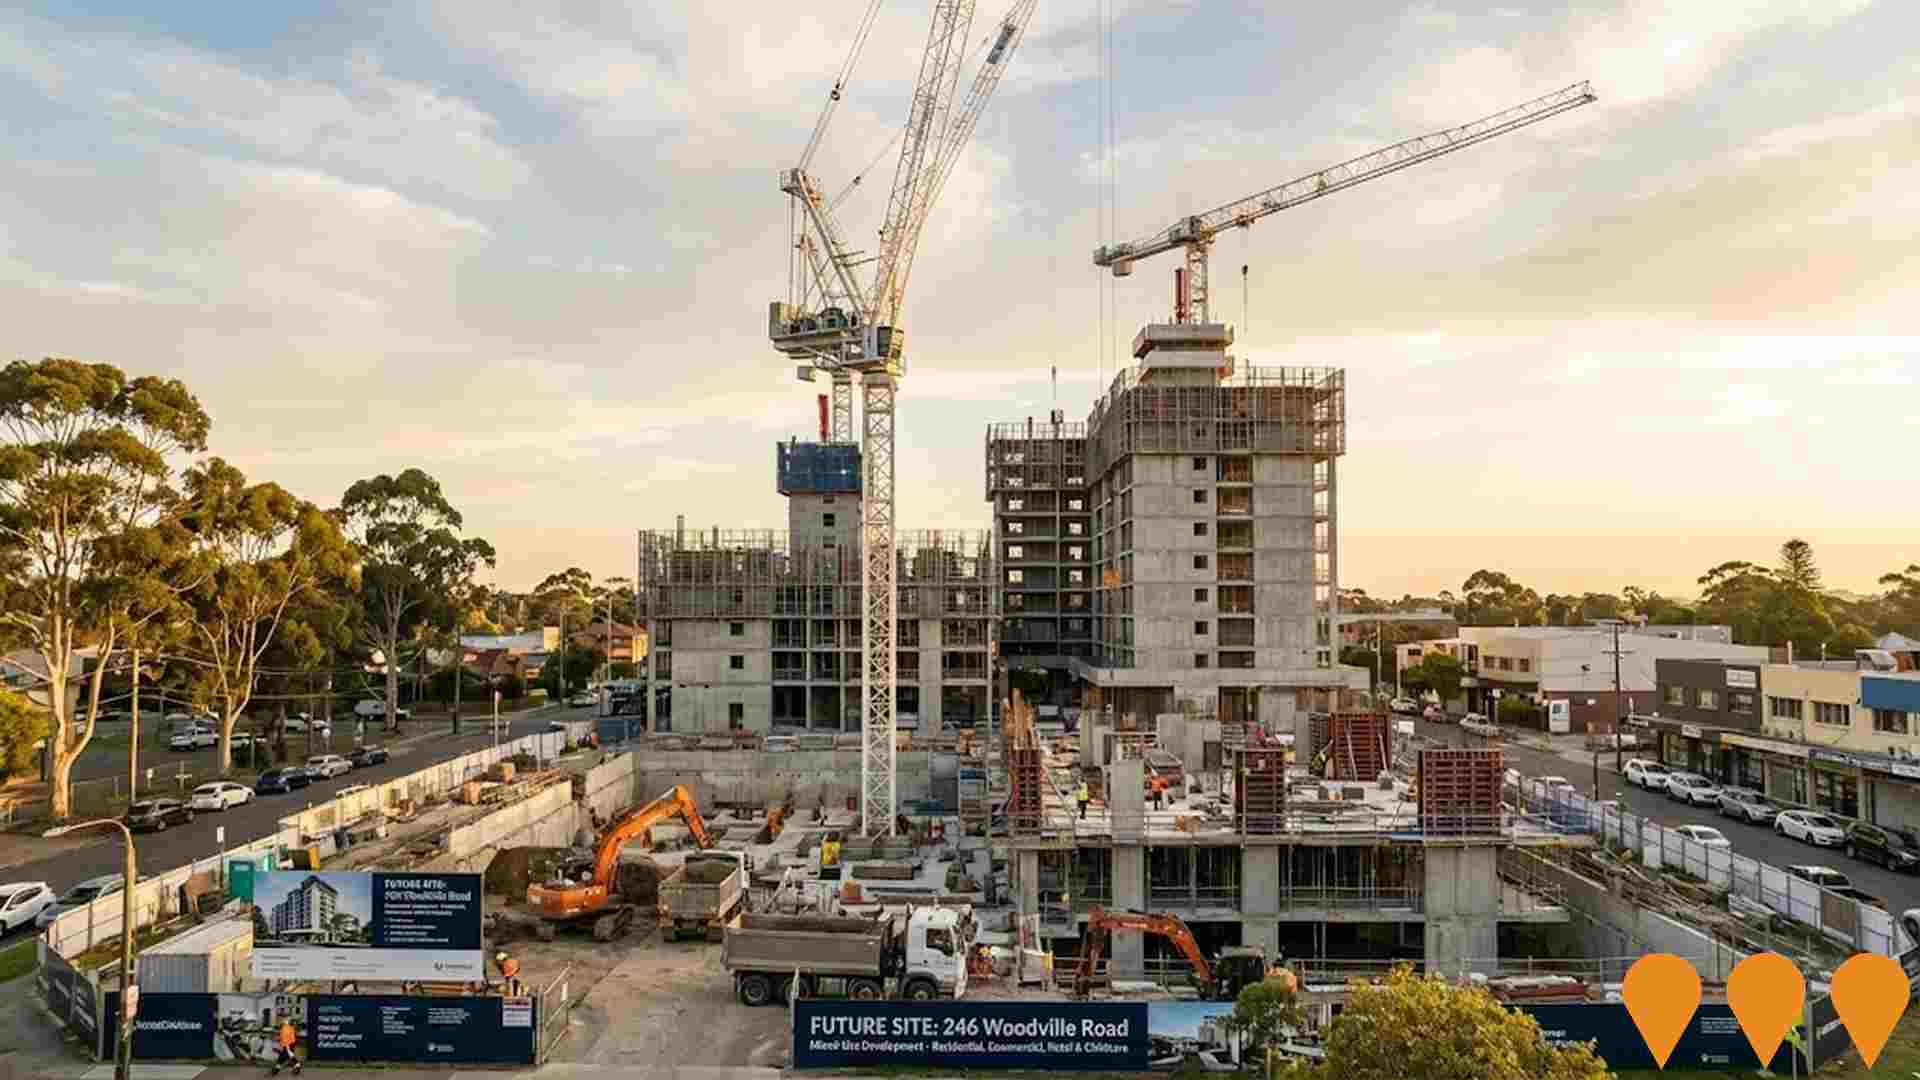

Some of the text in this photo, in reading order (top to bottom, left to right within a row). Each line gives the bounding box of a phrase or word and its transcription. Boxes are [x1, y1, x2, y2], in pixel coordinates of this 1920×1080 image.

[811, 1016, 1129, 1037] FUTURE SITE: 246 Woodville Road
